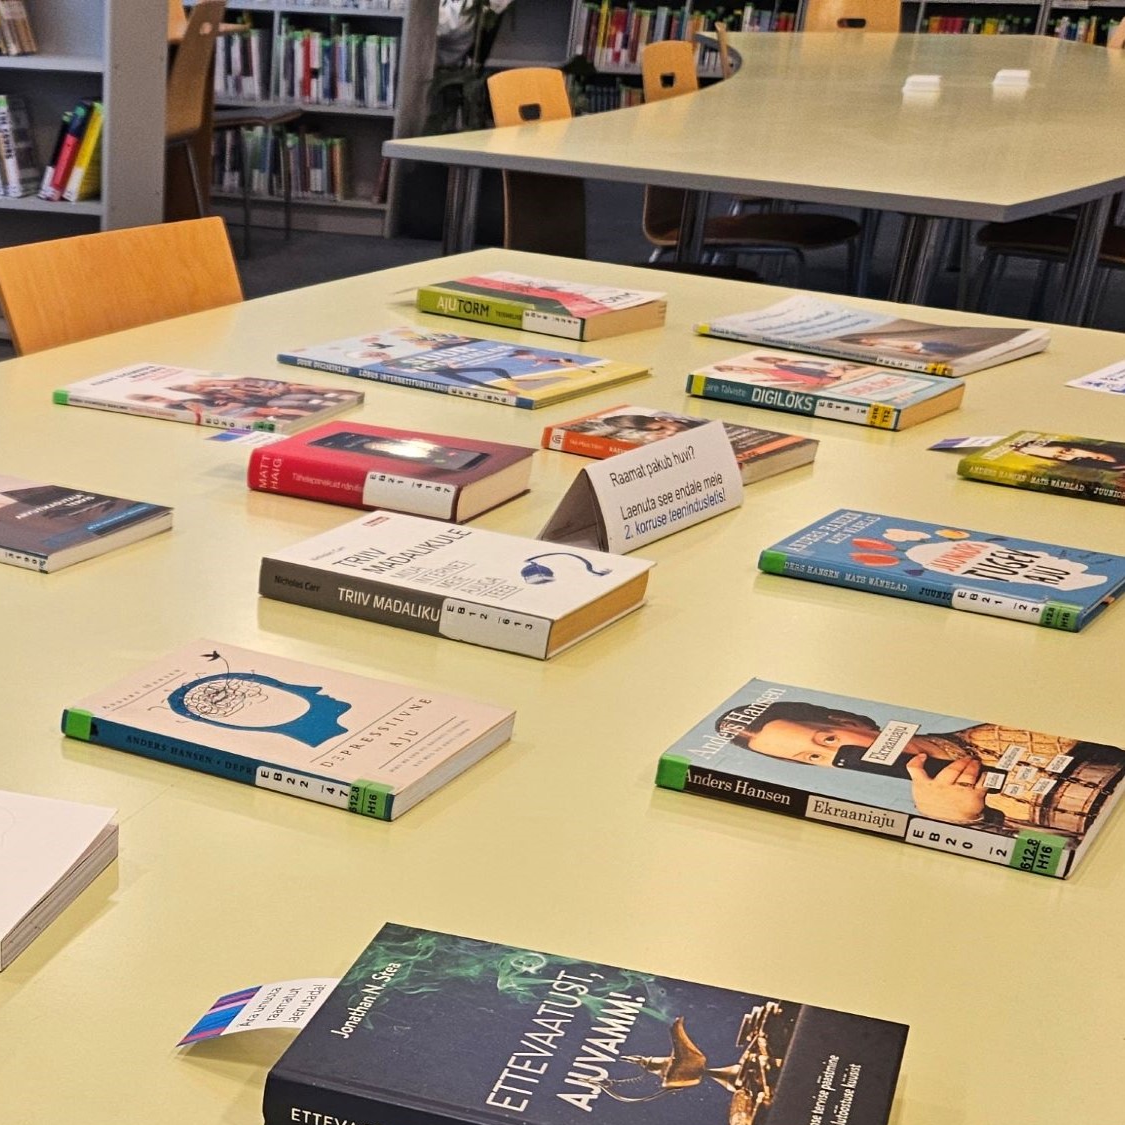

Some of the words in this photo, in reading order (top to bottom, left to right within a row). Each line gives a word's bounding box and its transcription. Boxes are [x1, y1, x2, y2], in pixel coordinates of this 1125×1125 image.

[751, 386, 814, 411] DIGILÕKS
[258, 455, 271, 488] MATT
[272, 458, 283, 490] HAIG
[609, 464, 647, 486] Raamat
[646, 455, 673, 478] pakub
[674, 445, 696, 465] huvi?
[620, 496, 657, 520] Laenuta
[658, 491, 674, 506] see
[675, 480, 703, 500] endale
[703, 471, 723, 491] meie
[625, 524, 634, 540] 2.
[636, 514, 668, 536] korruse
[668, 487, 726, 522] teenindusletis!
[332, 547, 386, 568] TRIIV
[362, 528, 472, 574] MADALIKULE
[962, 547, 1042, 582] TUGEV
[807, 565, 840, 580] HANSEN
[844, 572, 866, 584] MATS
[869, 576, 908, 592] WÄNBLAD
[275, 575, 303, 590] Nicholas
[304, 581, 321, 593] Carr
[337, 587, 370, 608] TRIIV
[373, 594, 440, 623] MADALIKU
[390, 729, 420, 748] AJU
[686, 722, 746, 760] Anders
[724, 686, 786, 728] Hansen
[126, 734, 166, 751] ANDERS
[170, 747, 214, 765] HANSEN
[869, 725, 908, 762] Ekraaniaju
[368, 794, 378, 814] H16
[684, 768, 732, 792] Anders
[736, 780, 791, 806] Hansen
[812, 800, 896, 830] Ekraaniaju
[1020, 838, 1040, 872] 612.8
[1036, 844, 1054, 870] H16
[370, 980, 385, 999] N.
[372, 962, 402, 985] Stea
[282, 984, 327, 1024] laenutada!
[330, 991, 376, 1039] Jonathan
[486, 970, 604, 1112] ETTEVAATUST,
[556, 991, 646, 1112] AJUVAMM!
[817, 1054, 840, 1092] päästmine
[840, 1063, 862, 1089] küüsist
[811, 1089, 830, 1115] tervise
